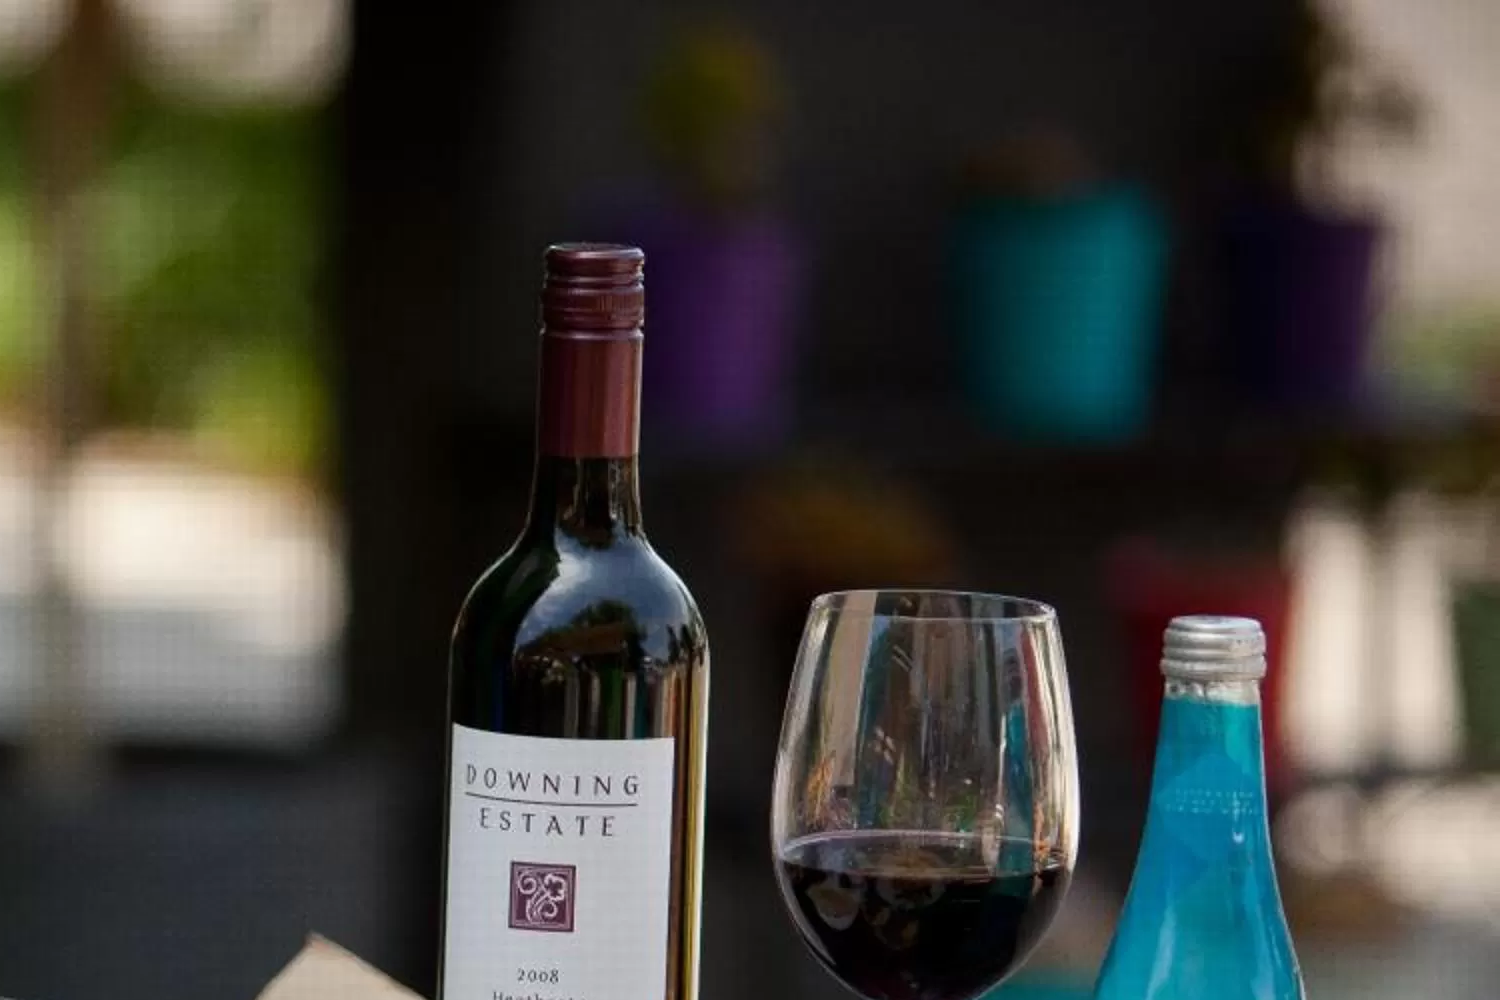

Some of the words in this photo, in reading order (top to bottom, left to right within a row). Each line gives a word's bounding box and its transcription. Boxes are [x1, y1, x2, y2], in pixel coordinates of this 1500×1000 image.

[466, 763, 640, 797] DOWNING
[479, 807, 616, 837] ESTATE
[516, 967, 560, 985] 2008
